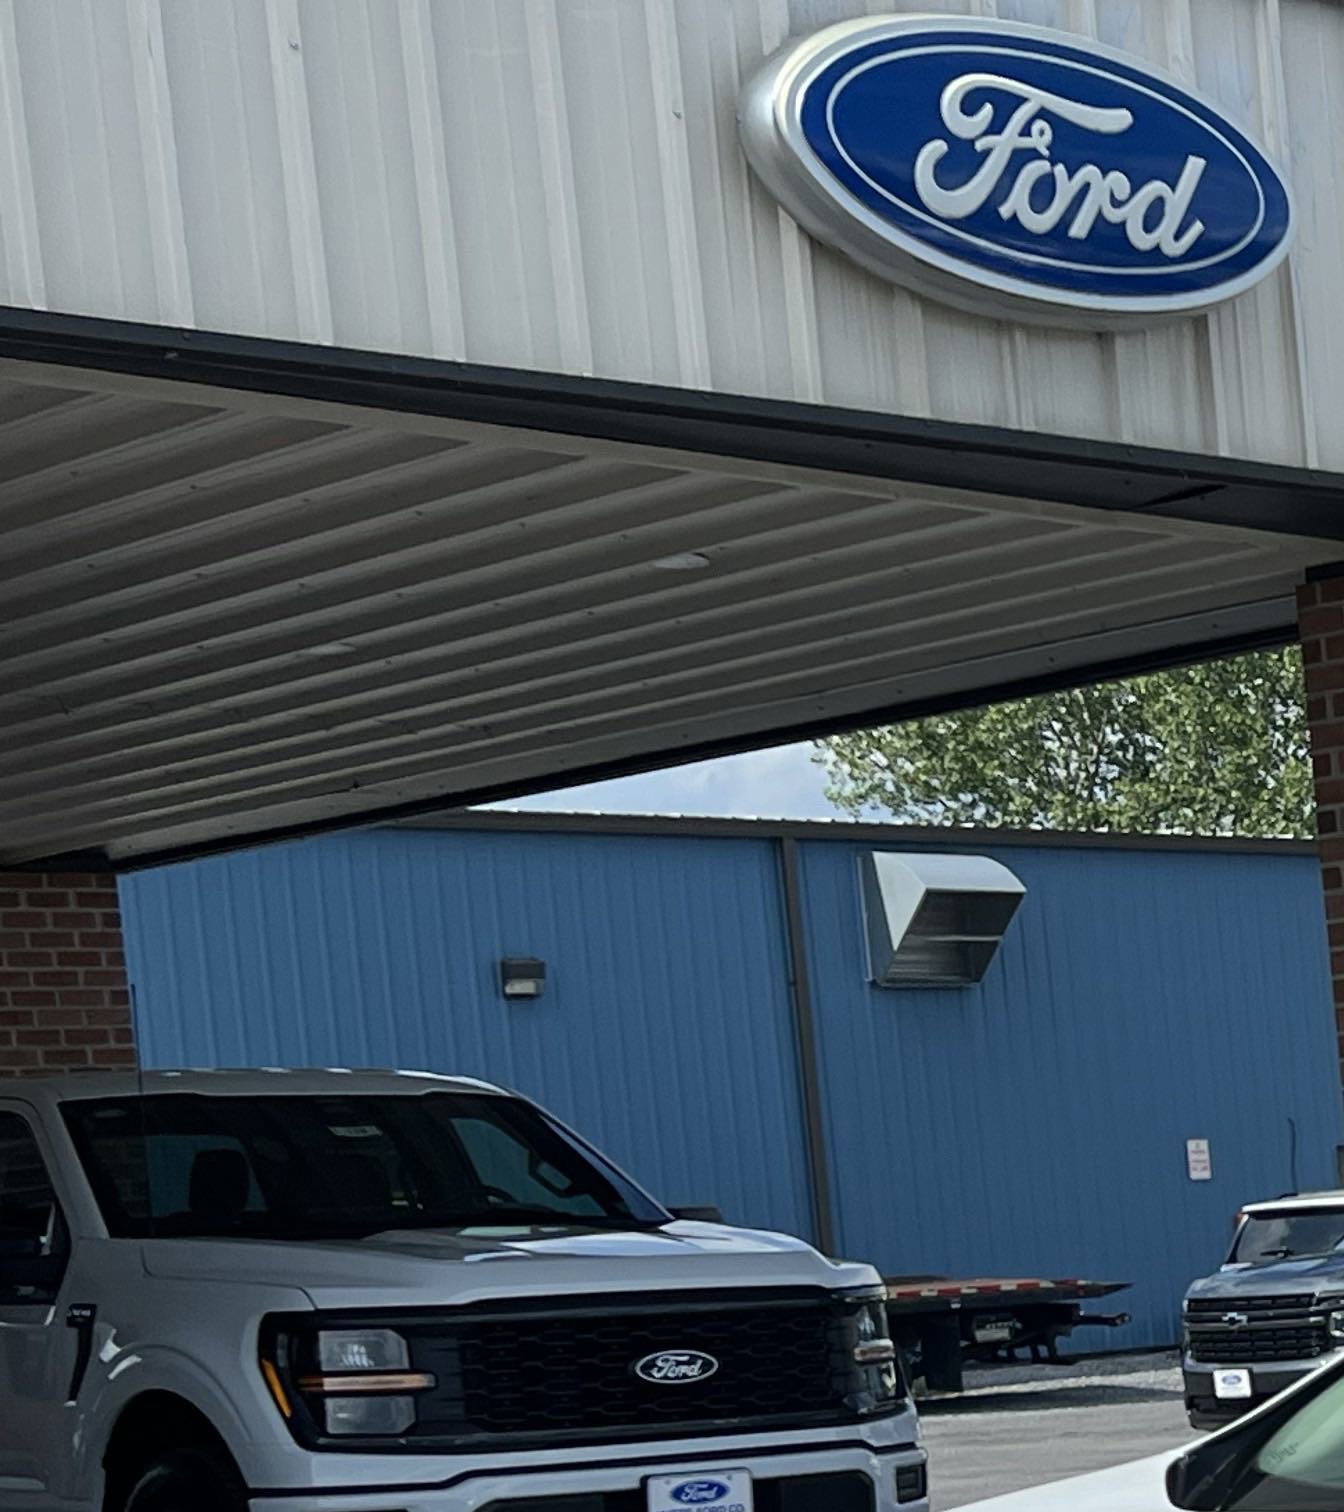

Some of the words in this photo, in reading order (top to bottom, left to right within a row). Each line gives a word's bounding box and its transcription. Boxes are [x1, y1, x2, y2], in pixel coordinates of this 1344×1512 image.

[914, 73, 1206, 258] Ford
[651, 1355, 702, 1378] Ford
[682, 1483, 718, 1501] Ford
